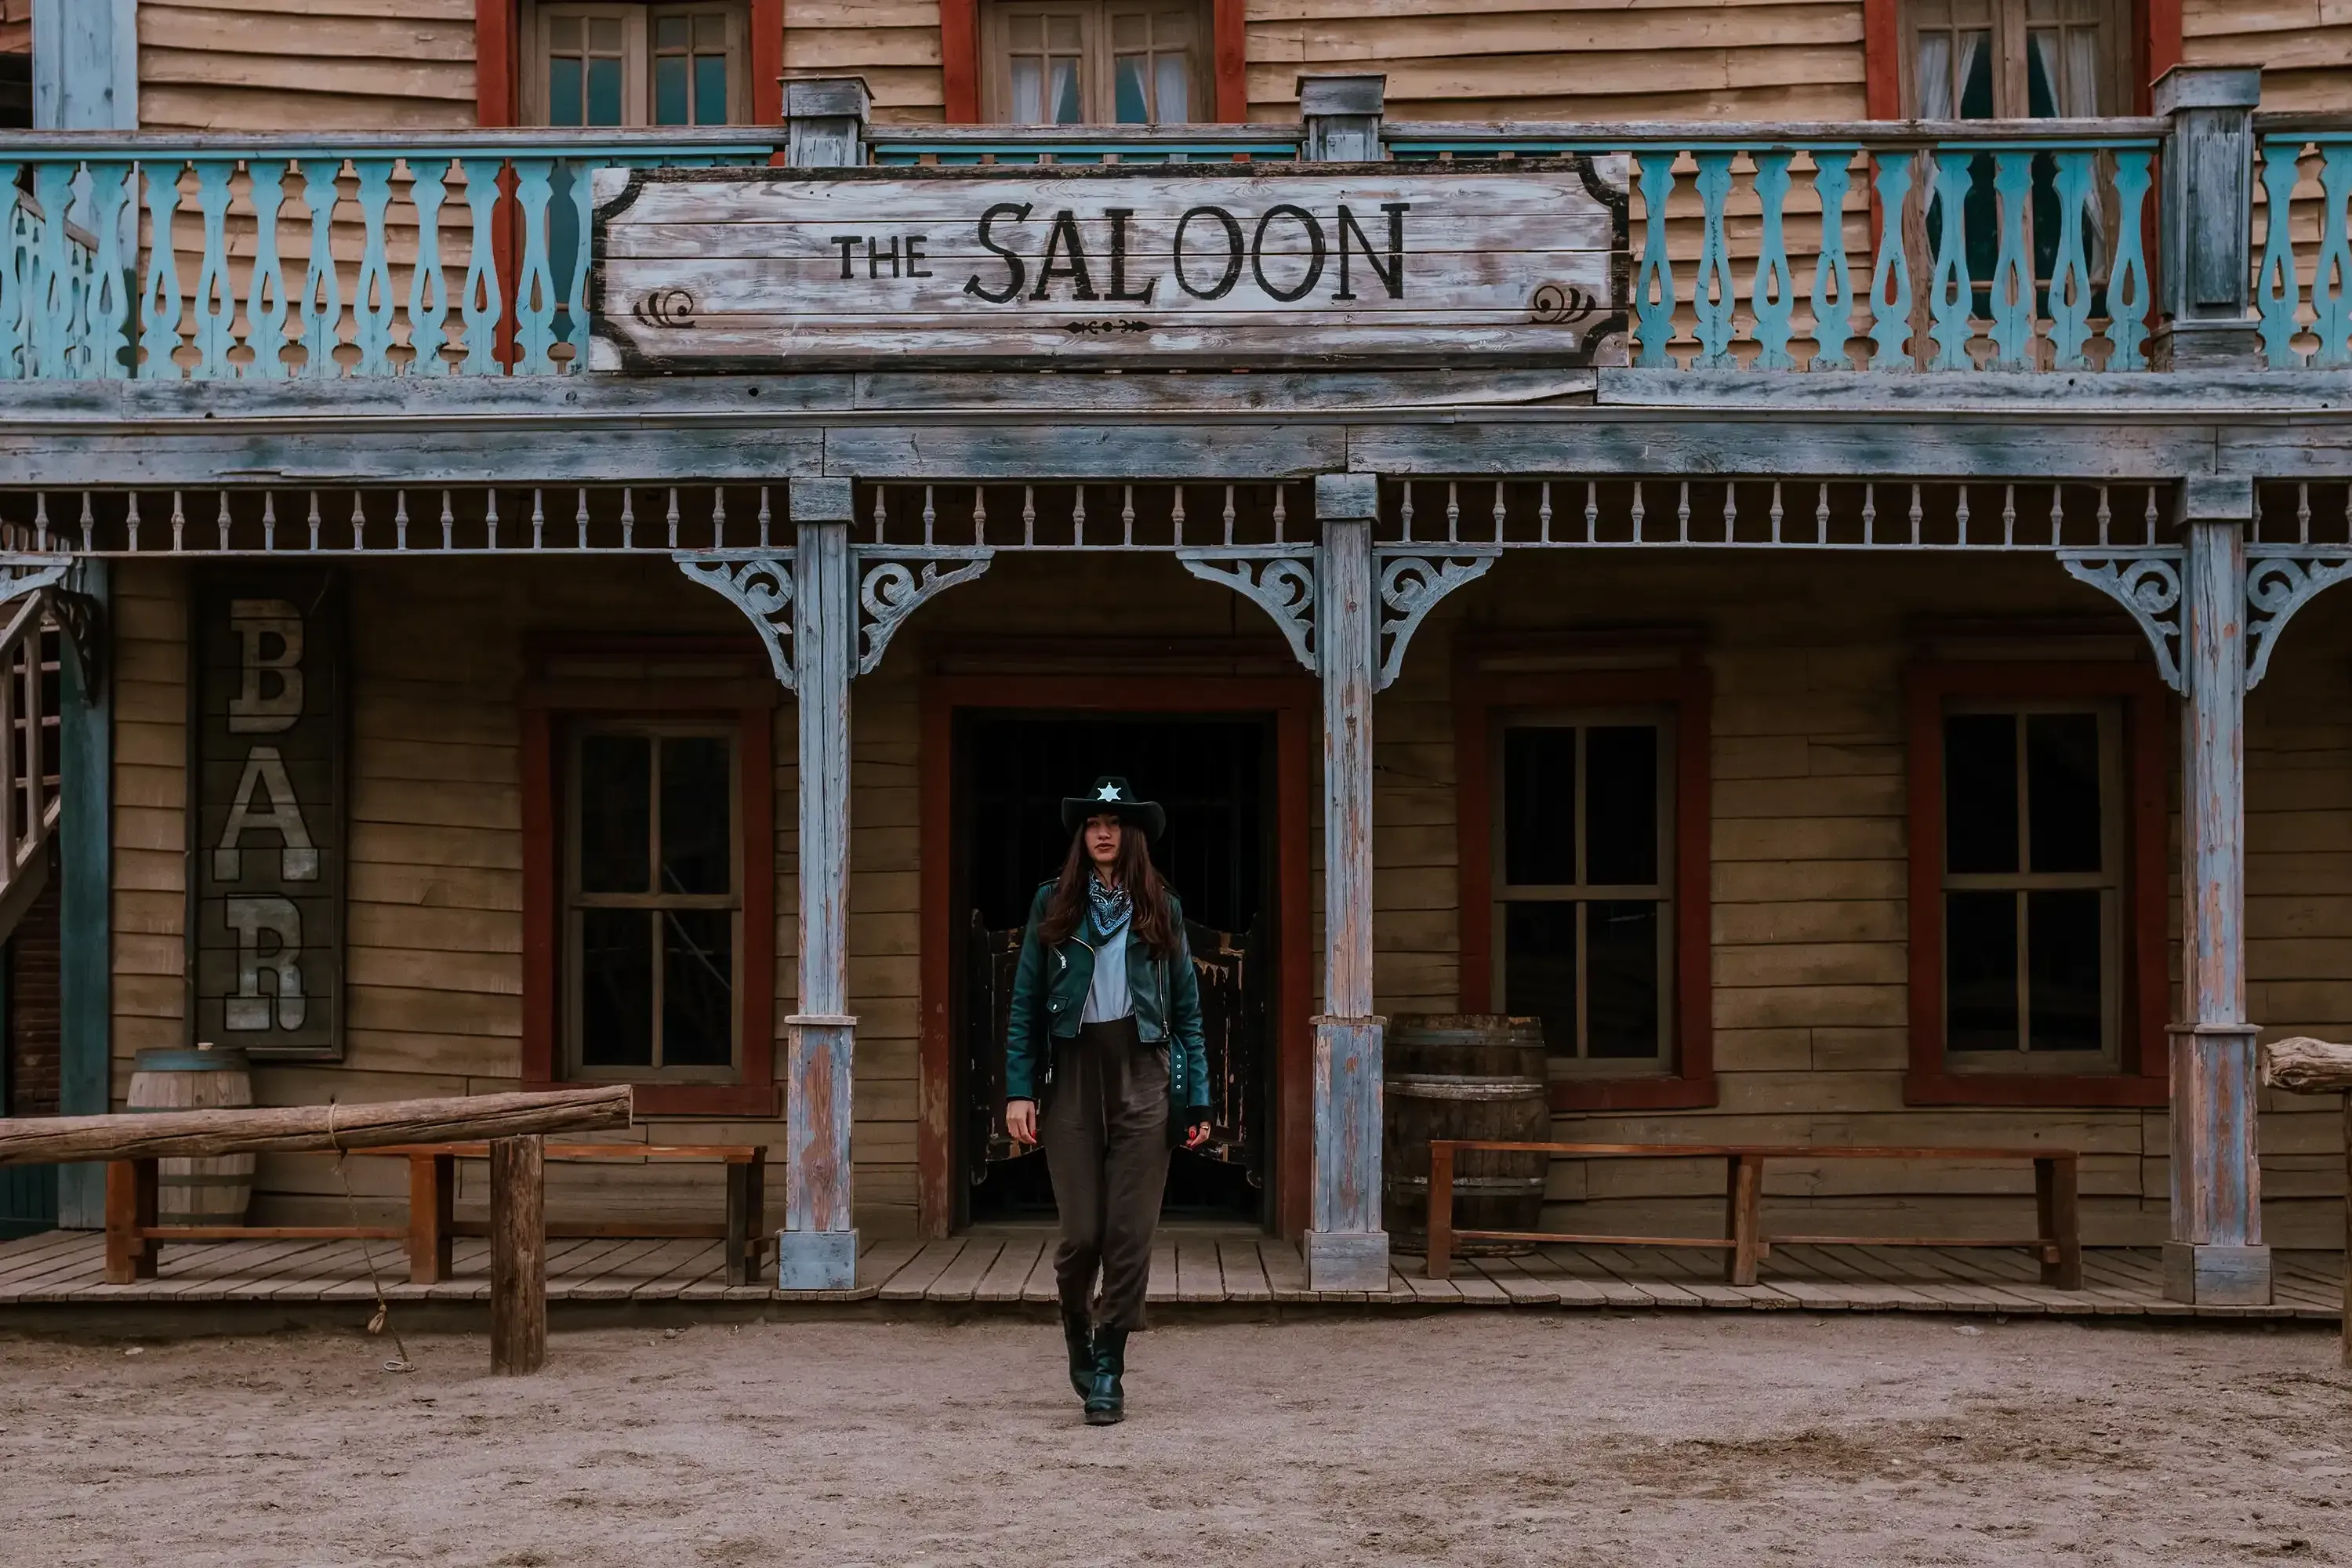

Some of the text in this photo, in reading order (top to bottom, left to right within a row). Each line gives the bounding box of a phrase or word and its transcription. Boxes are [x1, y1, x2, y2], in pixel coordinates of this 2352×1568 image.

[830, 201, 1411, 303] THE SALOON
[213, 598, 318, 1031] BAR
